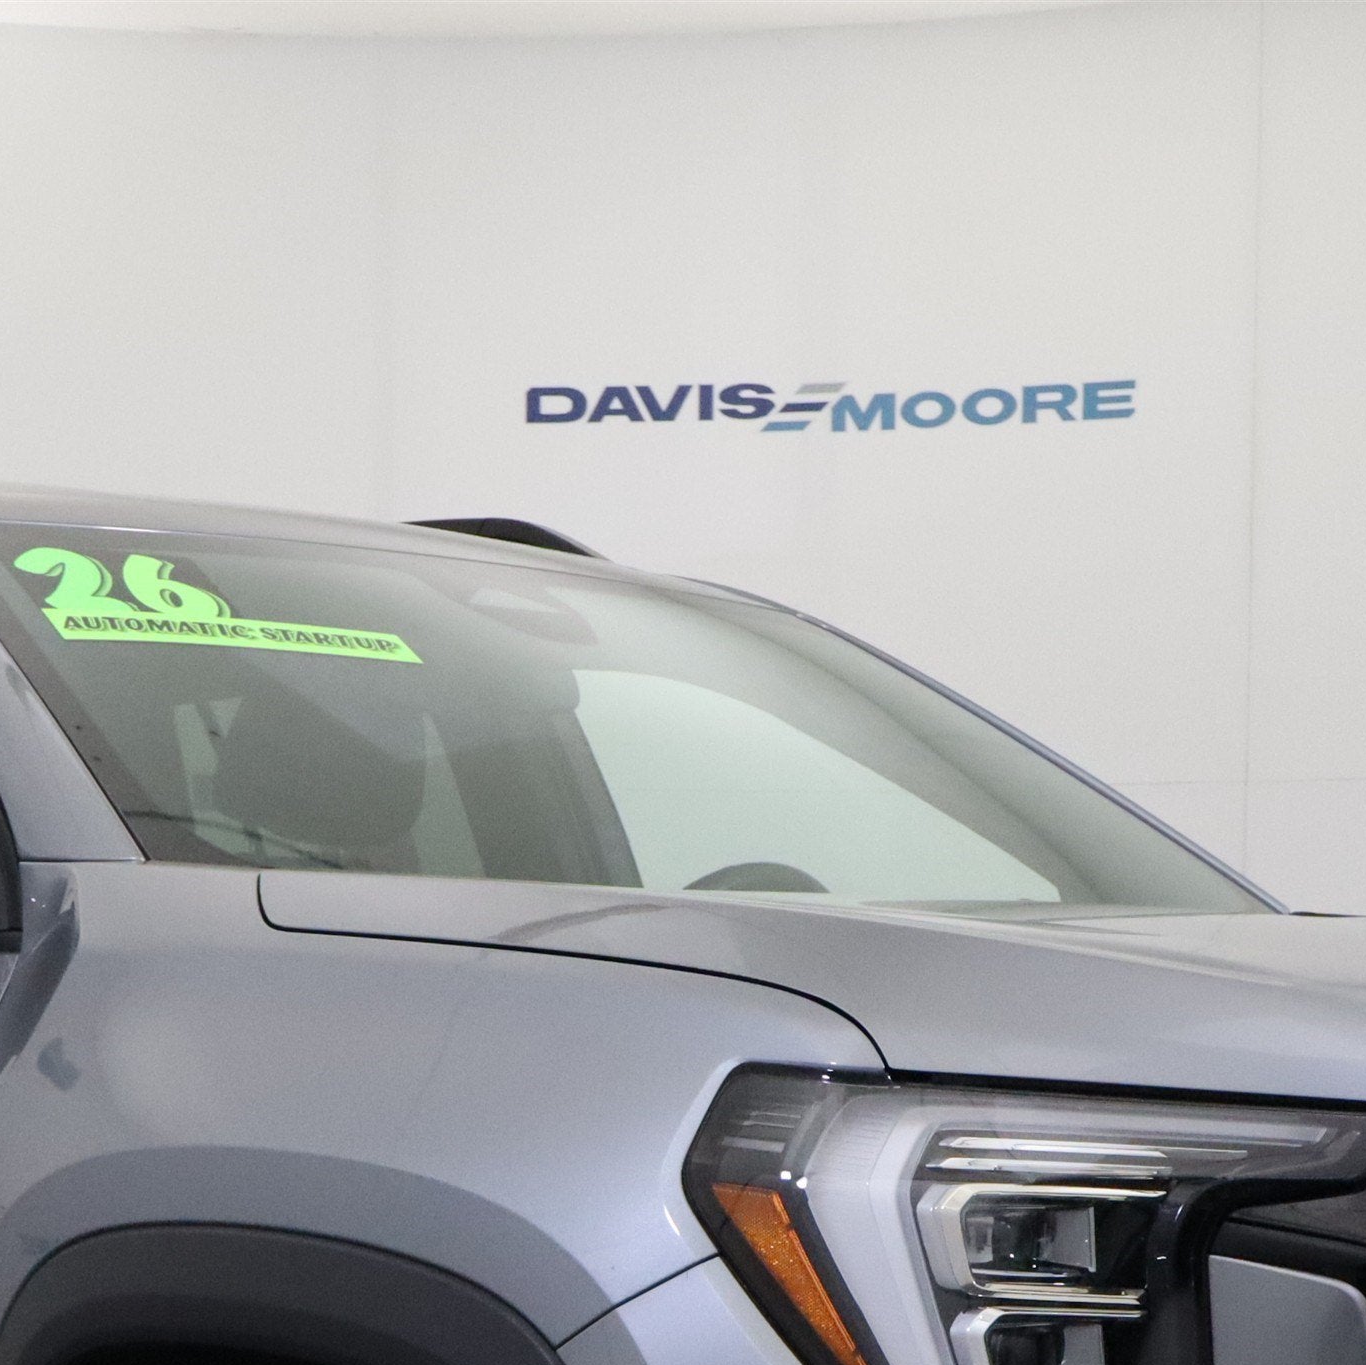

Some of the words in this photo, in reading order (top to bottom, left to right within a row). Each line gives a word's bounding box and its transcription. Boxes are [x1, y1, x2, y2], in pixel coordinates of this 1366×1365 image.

[526, 383, 775, 423] DAVIS
[831, 380, 1136, 433] MOORE
[13, 547, 231, 619] 26
[64, 615, 254, 639] AUTOMATIC
[261, 627, 401, 654] STARTUP
